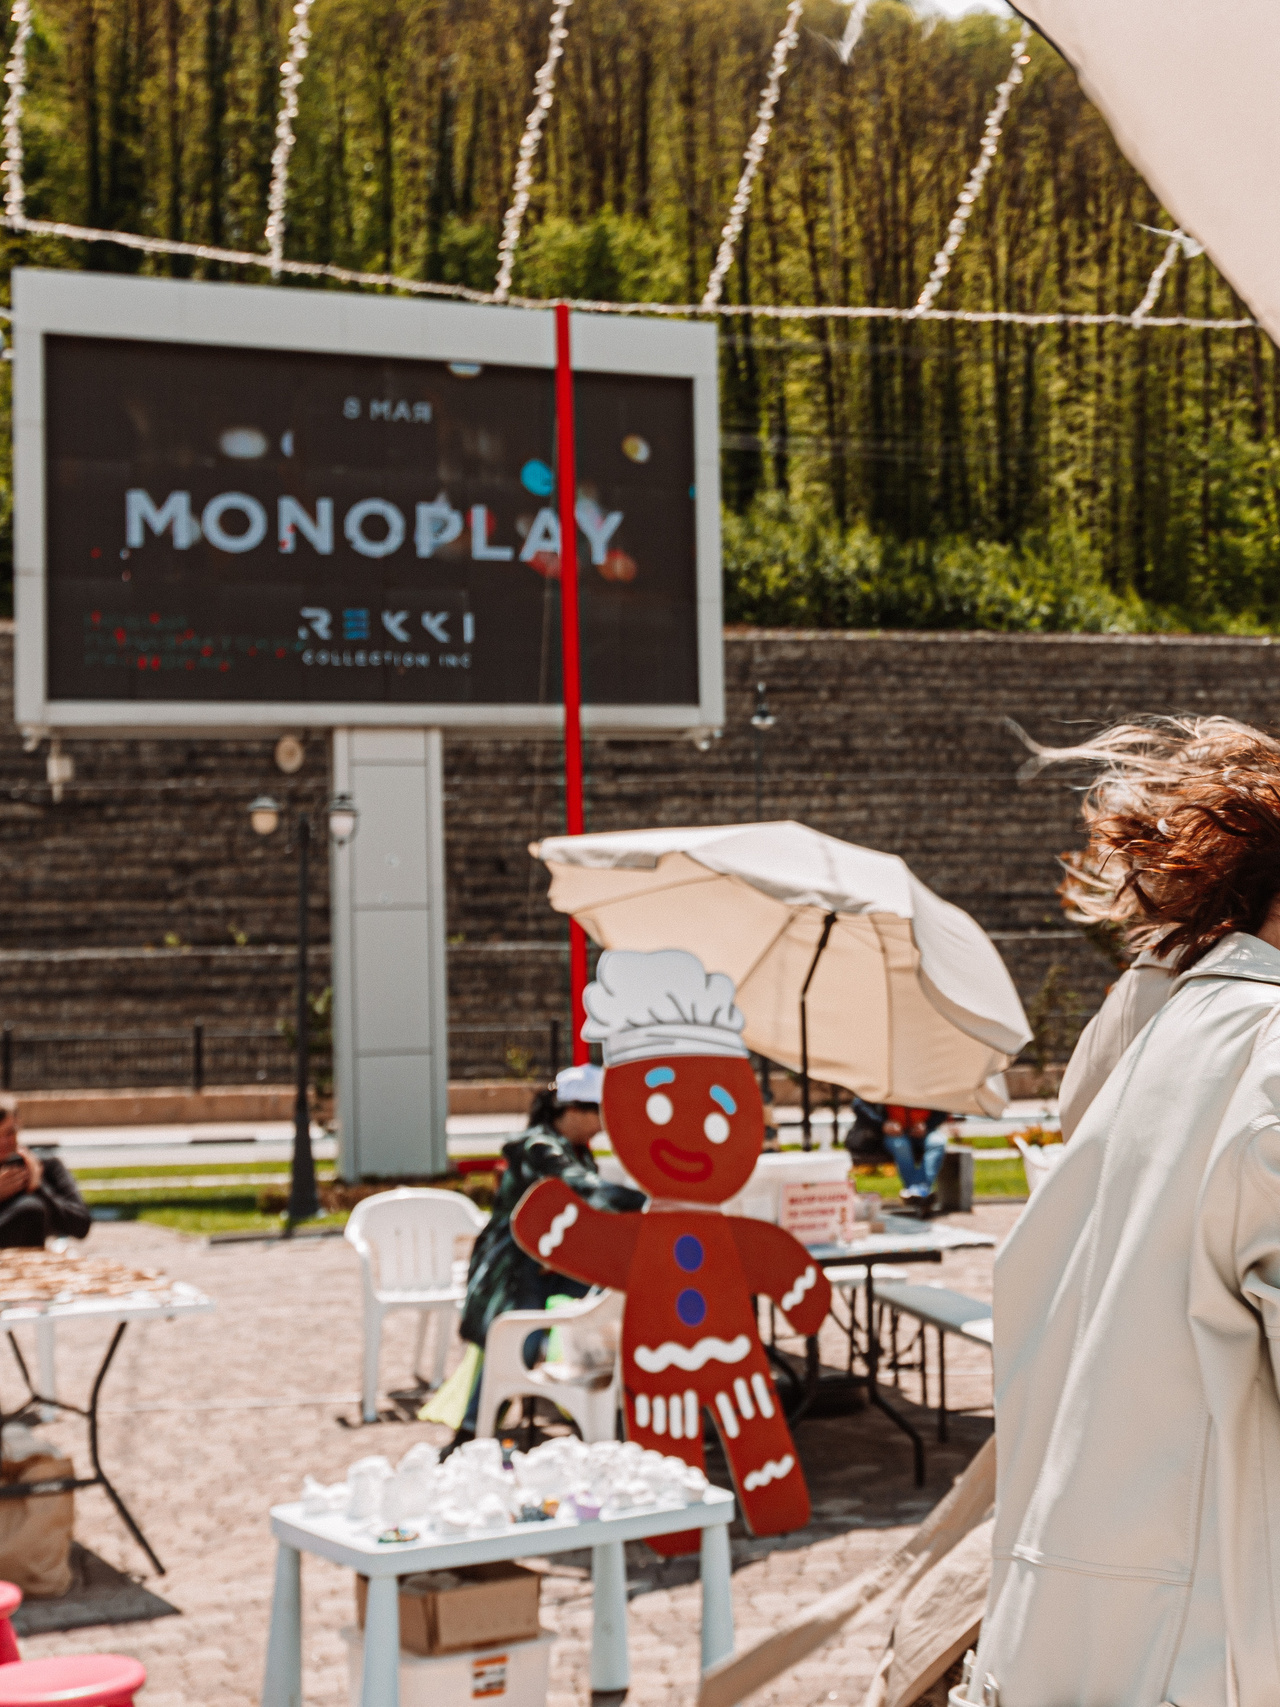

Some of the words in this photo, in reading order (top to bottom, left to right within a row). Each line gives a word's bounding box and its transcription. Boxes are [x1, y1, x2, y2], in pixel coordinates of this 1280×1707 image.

[343, 397, 361, 420] 8
[125, 488, 624, 565] MONOPLAY
[298, 607, 475, 644] REKKI
[302, 650, 430, 667] COLLECTION
